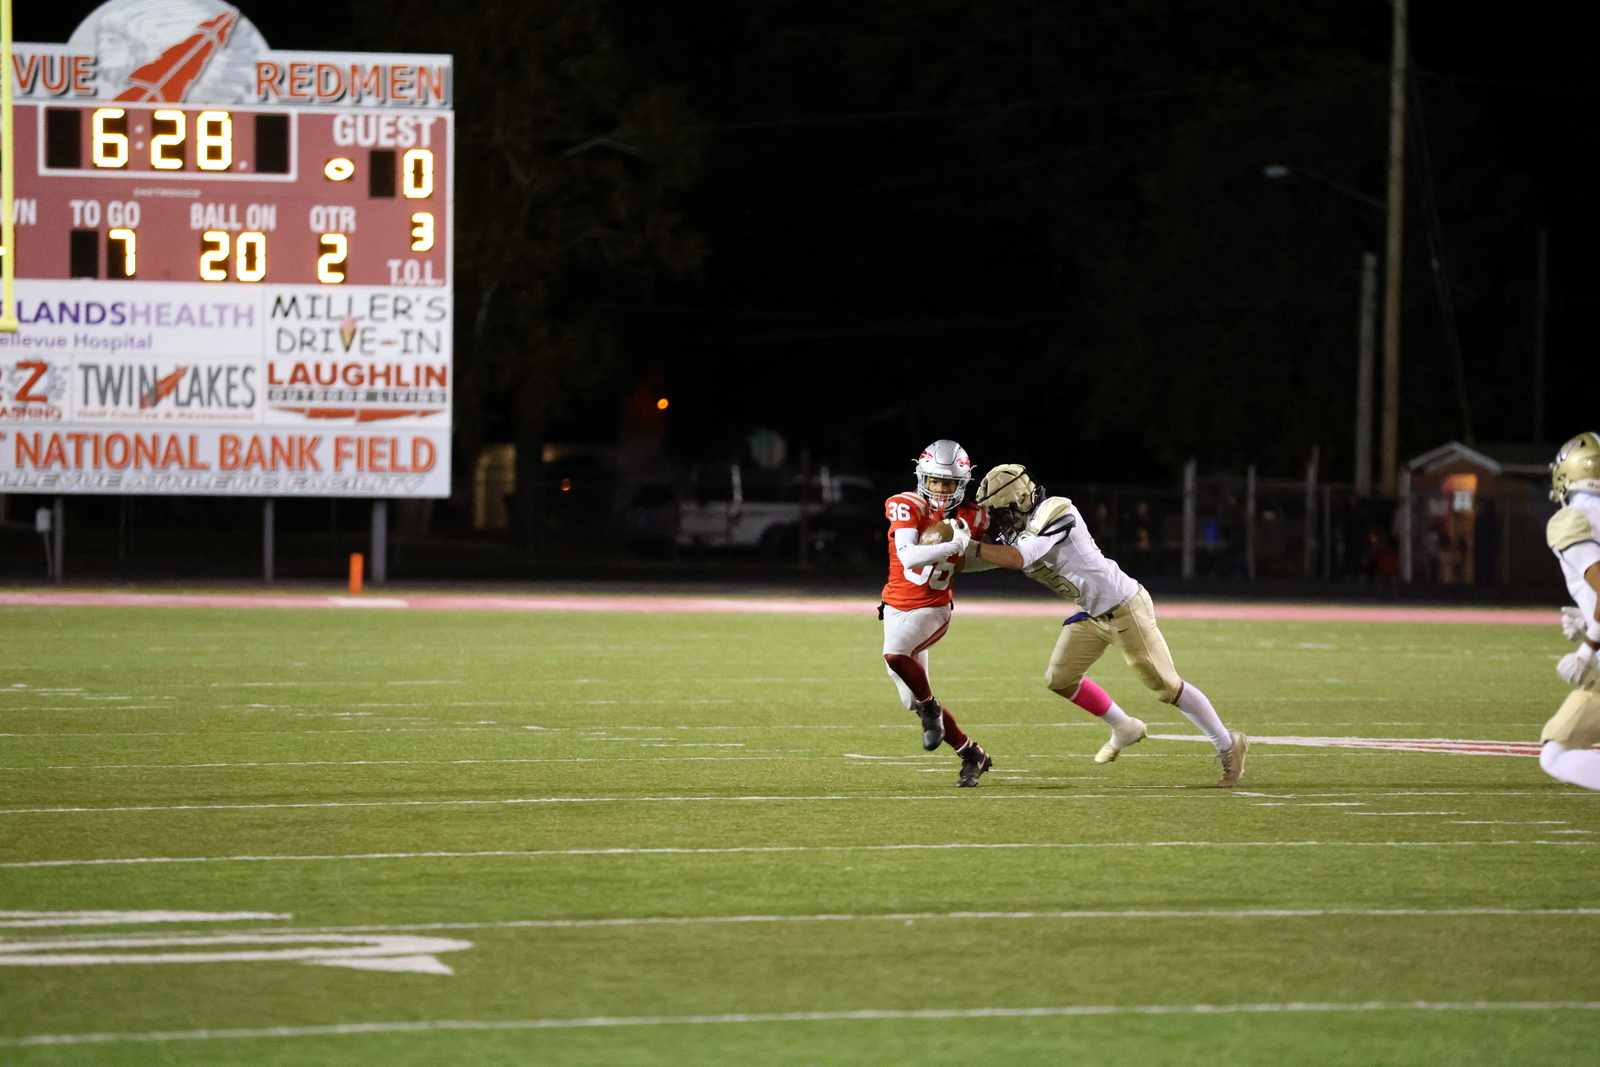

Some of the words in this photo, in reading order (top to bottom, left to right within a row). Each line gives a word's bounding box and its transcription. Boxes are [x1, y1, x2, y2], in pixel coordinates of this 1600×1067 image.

[0, 54, 98, 96] VUE
[256, 61, 448, 105] REDMEN
[92, 108, 233, 170] 6:28
[333, 114, 437, 147] GUEST
[403, 149, 434, 198] 0
[70, 199, 100, 226] TO
[107, 201, 140, 227] GO
[191, 203, 242, 230] BALL
[246, 204, 277, 231] ON
[310, 205, 356, 233] QTR
[411, 212, 434, 251] 3
[109, 229, 136, 276] 7
[200, 231, 266, 282] 20
[318, 233, 348, 283] 2
[272, 293, 447, 322] MILLER'S
[74, 332, 153, 353] Hospital
[79, 361, 158, 408] TWIN
[175, 363, 256, 408] LAKES
[268, 361, 447, 387] LAUGHLIN
[15, 431, 210, 470] NATIONAL
[220, 433, 323, 472] BANK
[334, 434, 436, 474] FIELD
[888, 502, 911, 522] 36
